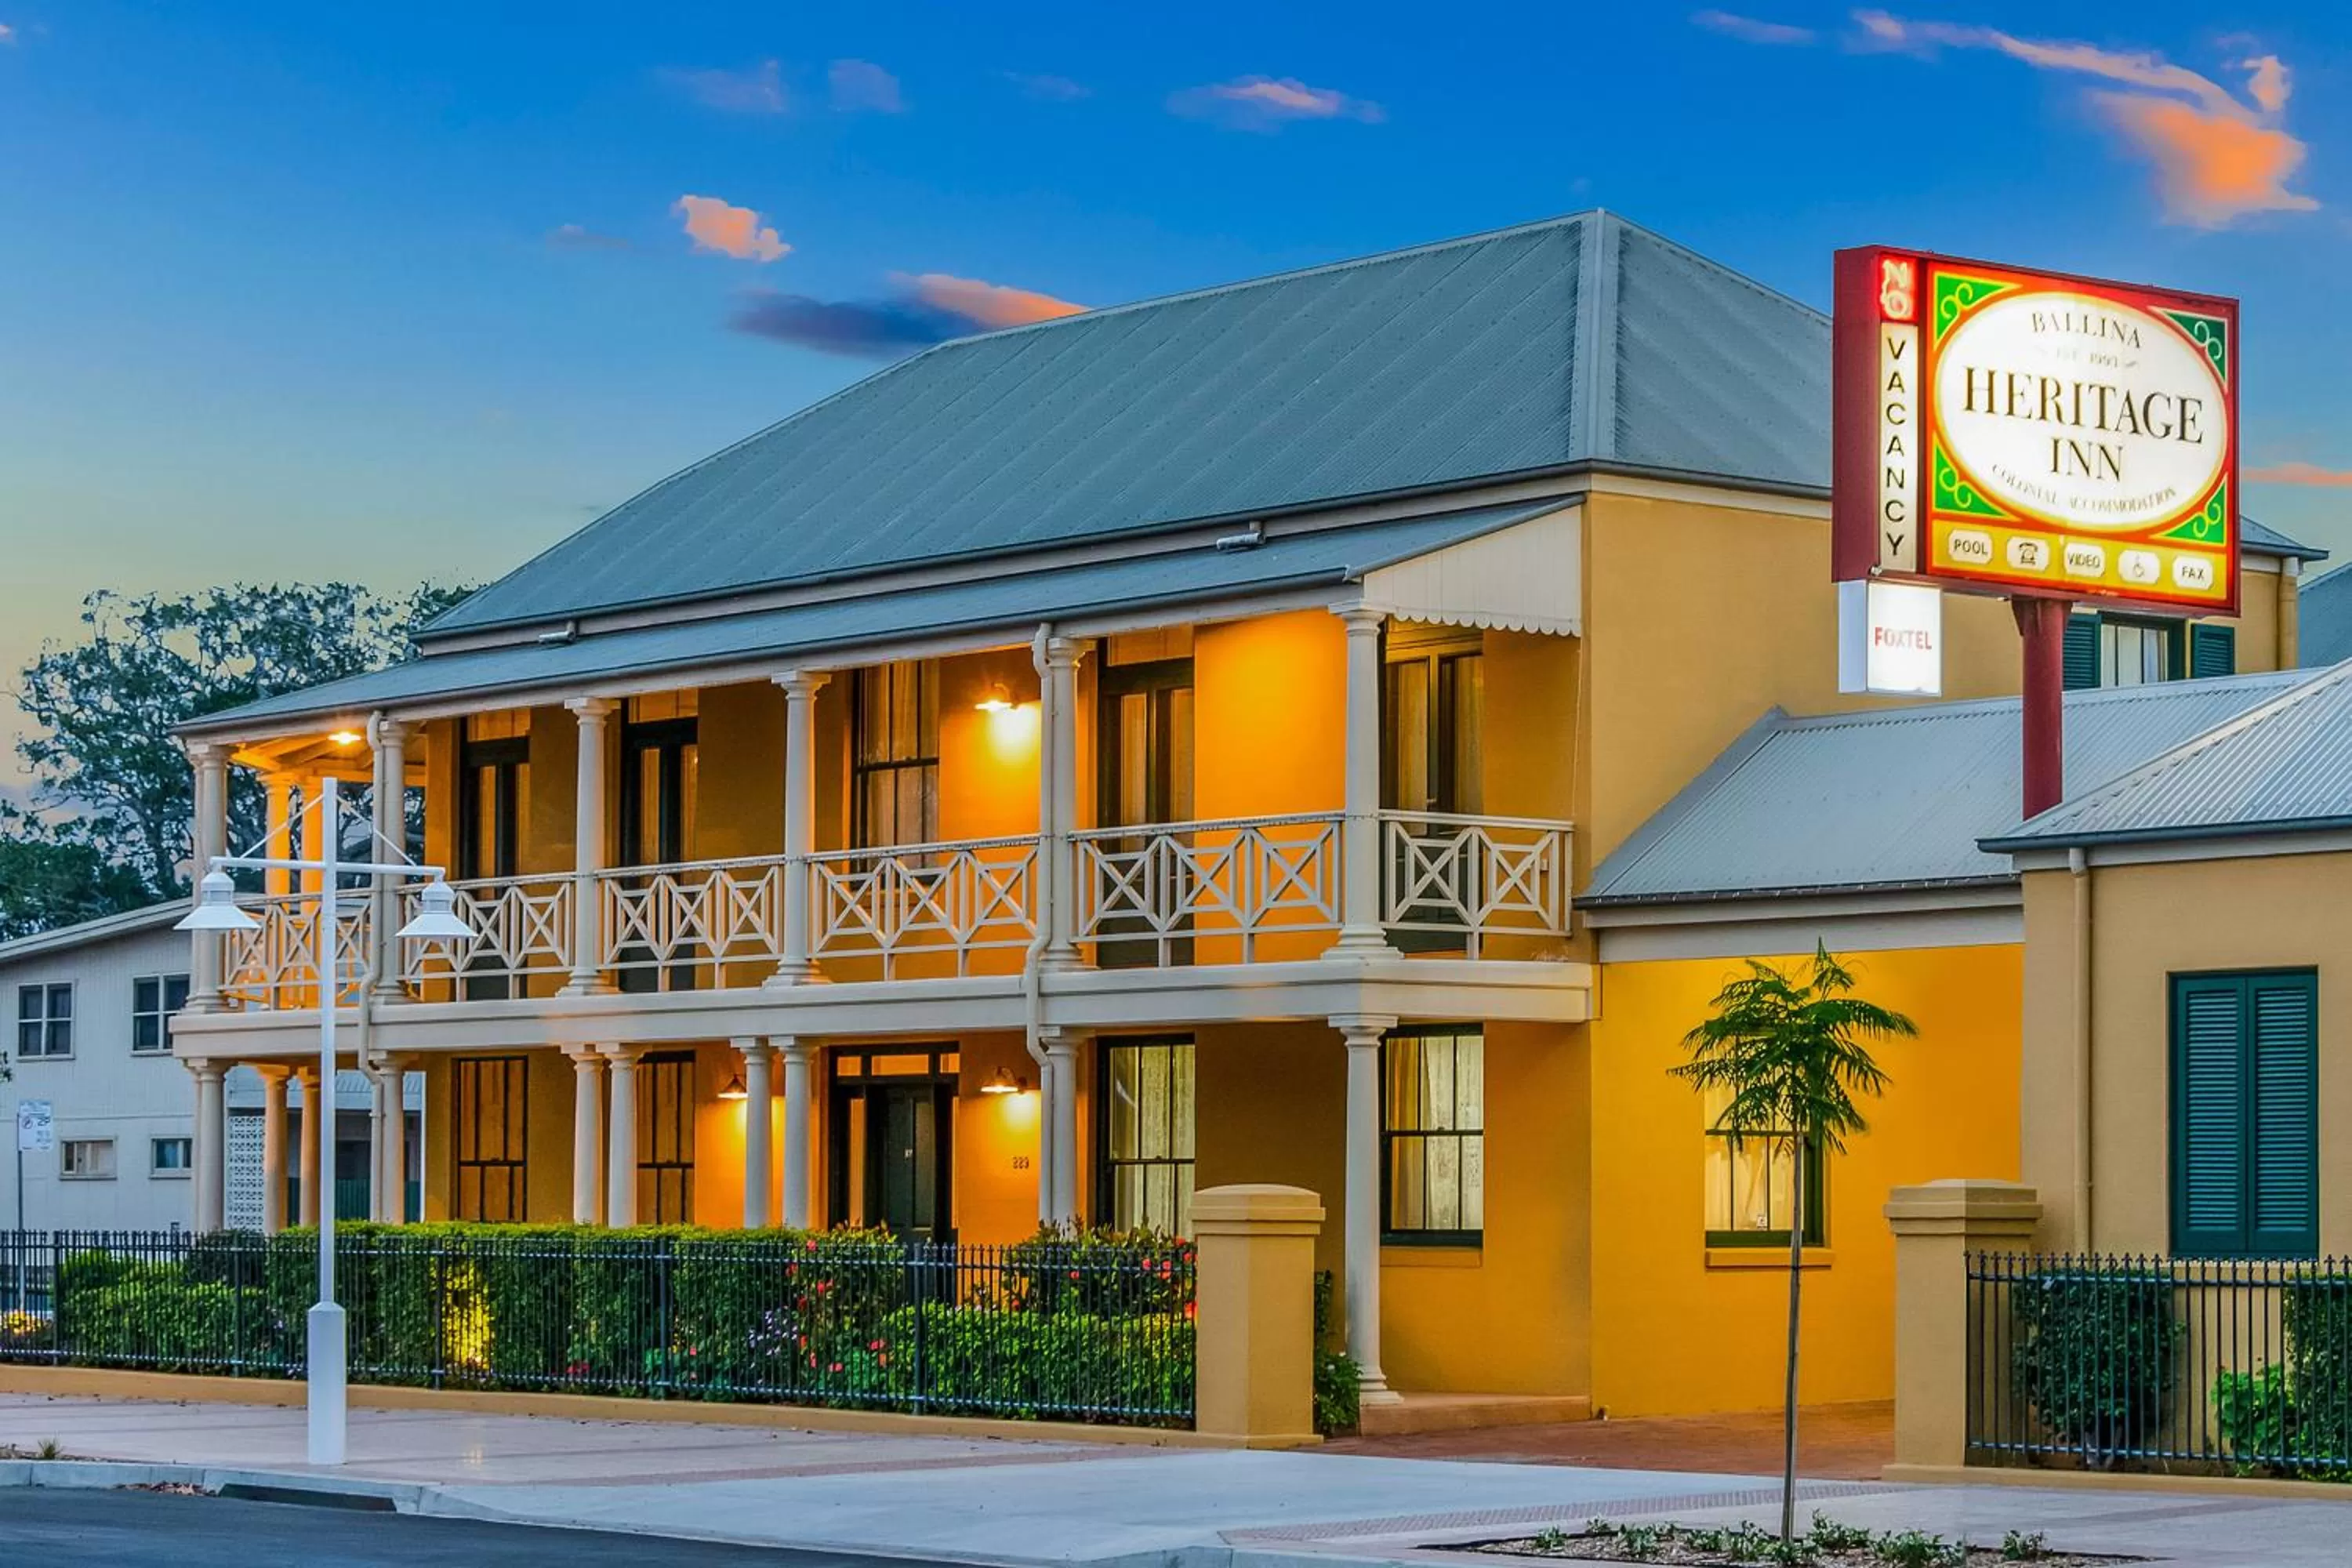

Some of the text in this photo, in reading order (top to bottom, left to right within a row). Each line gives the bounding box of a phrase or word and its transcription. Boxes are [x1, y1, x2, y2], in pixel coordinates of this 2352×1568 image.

[1880, 260, 1911, 320] NO
[2032, 311, 2141, 349] BALLINA
[1962, 366, 2204, 445] HERITAGE
[1885, 337, 1906, 556] VACANCY
[2050, 436, 2124, 481] INN
[1953, 538, 1988, 556] POOL
[2067, 553, 2101, 569] VIDEO
[2182, 565, 2205, 581] FAX
[1875, 626, 1933, 650] FOXTEL
